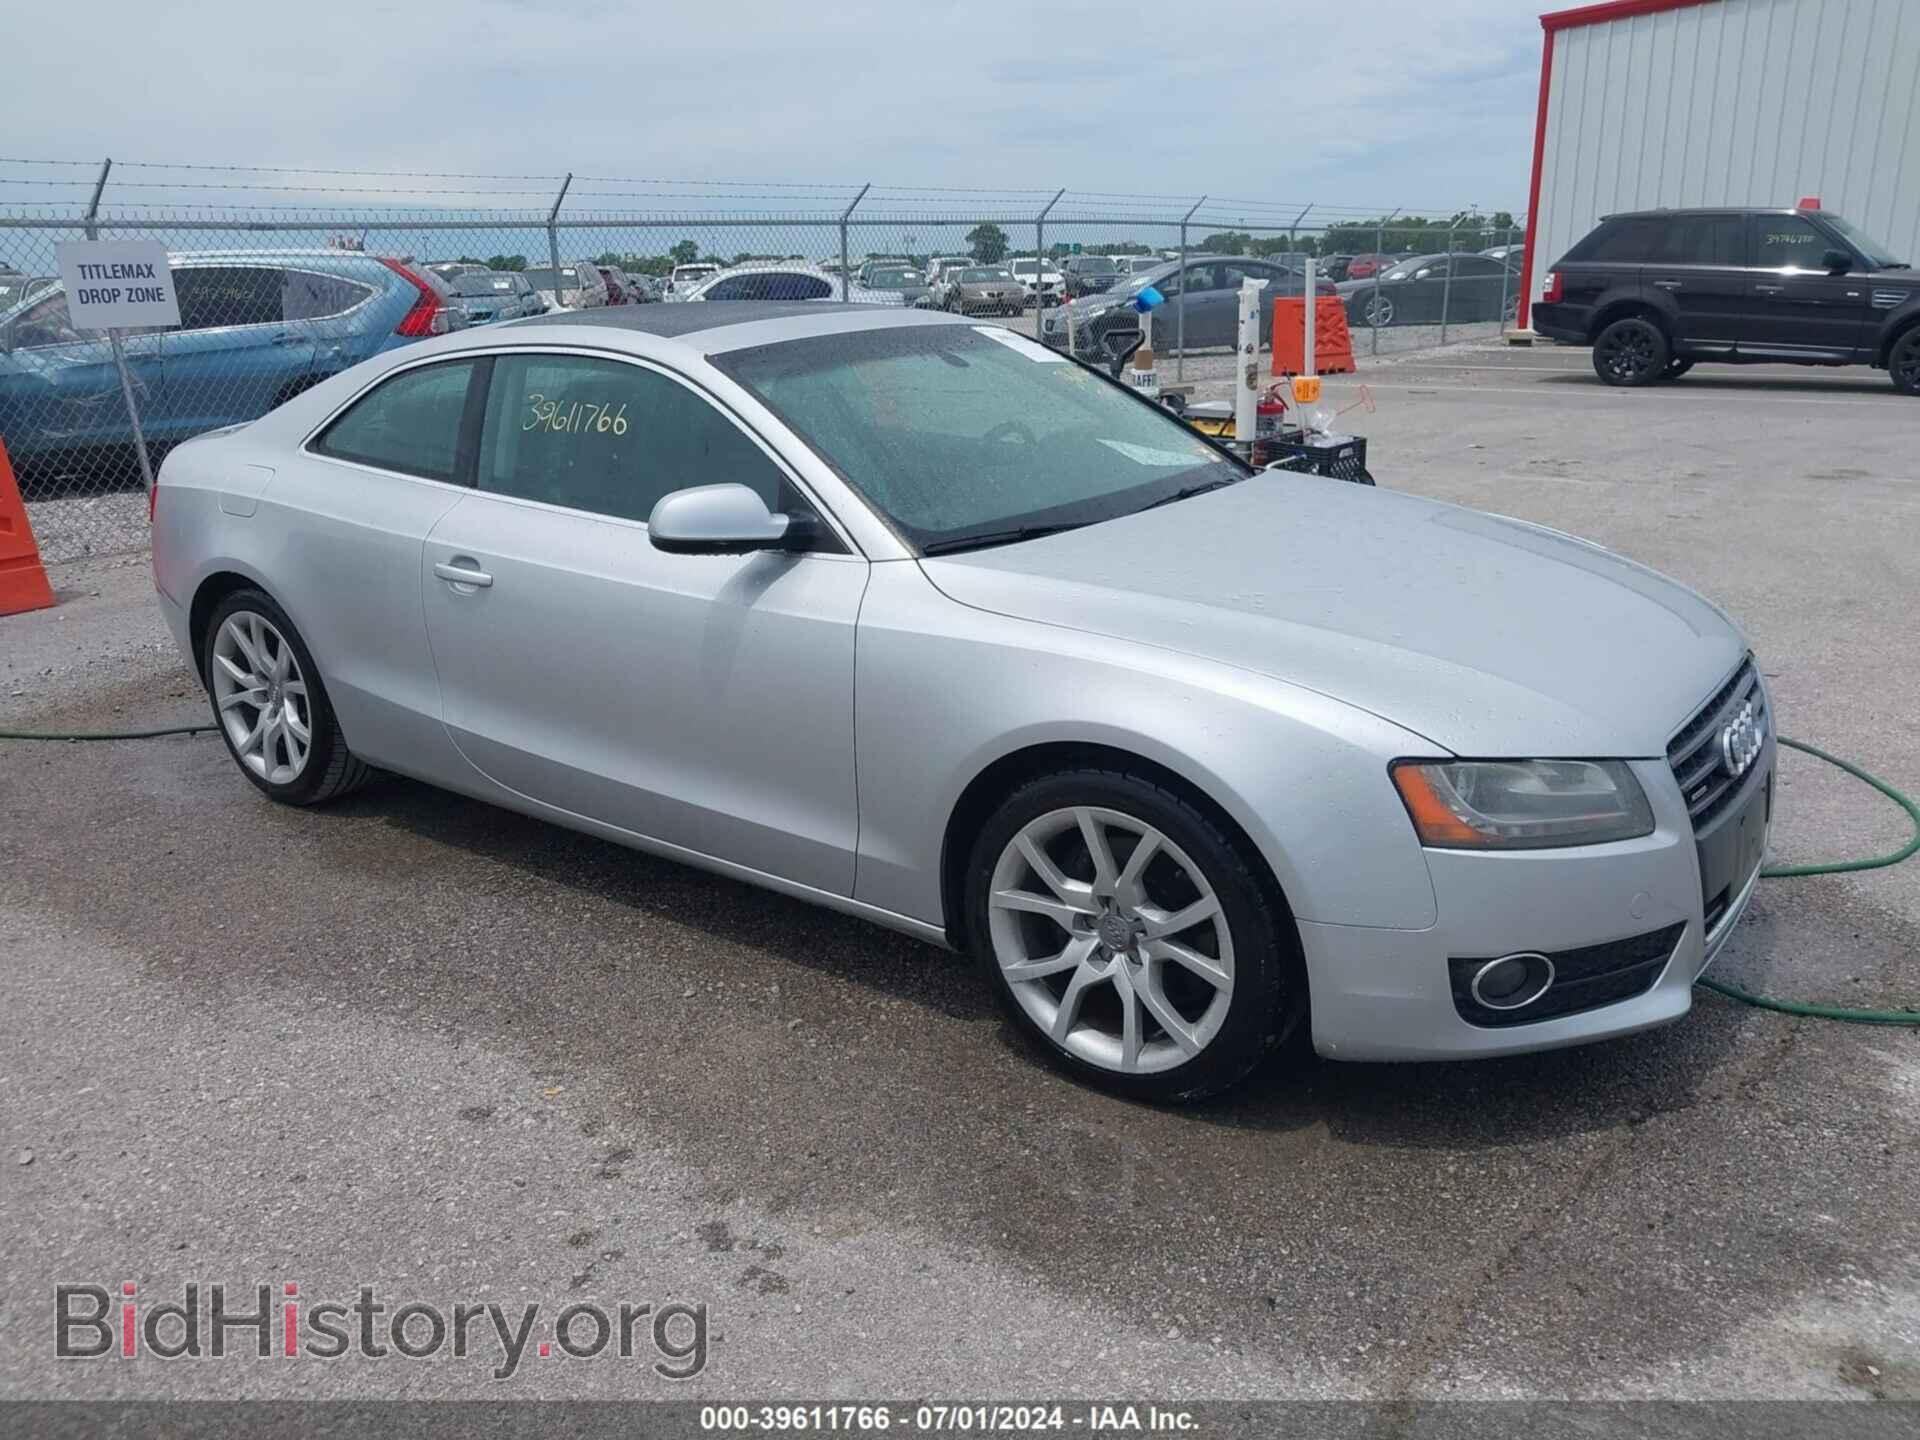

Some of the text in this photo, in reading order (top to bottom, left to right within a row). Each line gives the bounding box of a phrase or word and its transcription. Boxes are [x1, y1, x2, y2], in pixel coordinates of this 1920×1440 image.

[77, 263, 156, 280] TITLEMAX
[78, 286, 166, 305] DROP ZONE
[522, 393, 628, 435] 39611766
